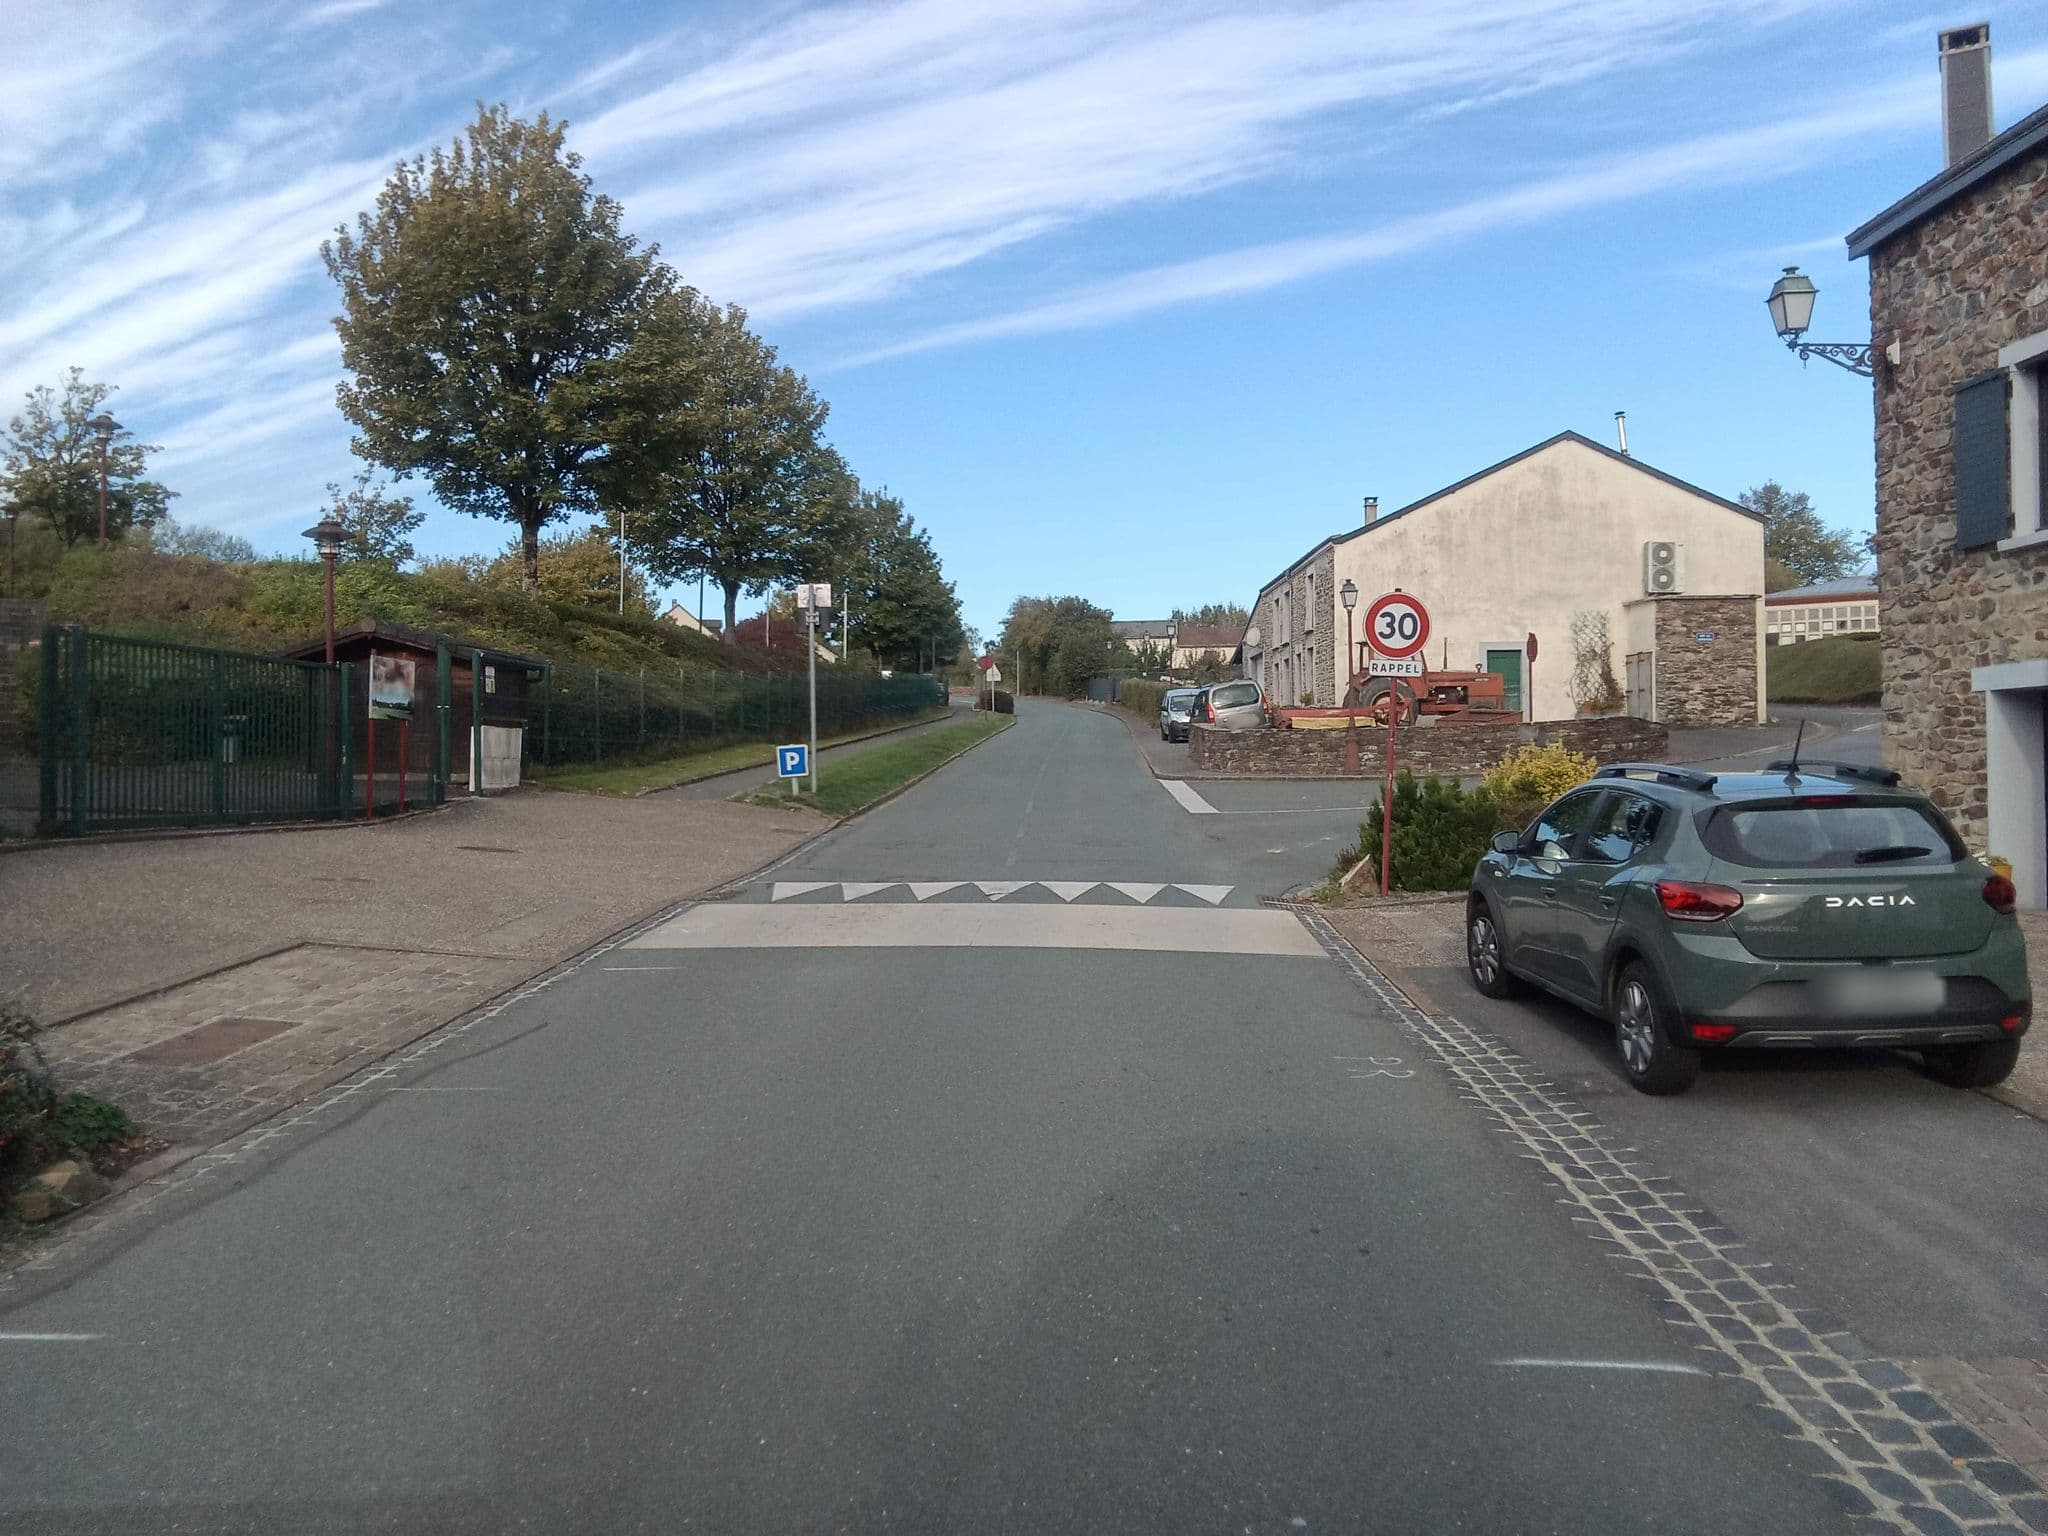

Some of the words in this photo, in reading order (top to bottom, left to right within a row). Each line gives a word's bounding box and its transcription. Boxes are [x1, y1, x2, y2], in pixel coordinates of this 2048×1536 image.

[1378, 611, 1419, 641] 30
[1371, 662, 1420, 674] RAPPEL
[785, 752, 800, 771] P
[1825, 895, 1917, 908] DACIA
